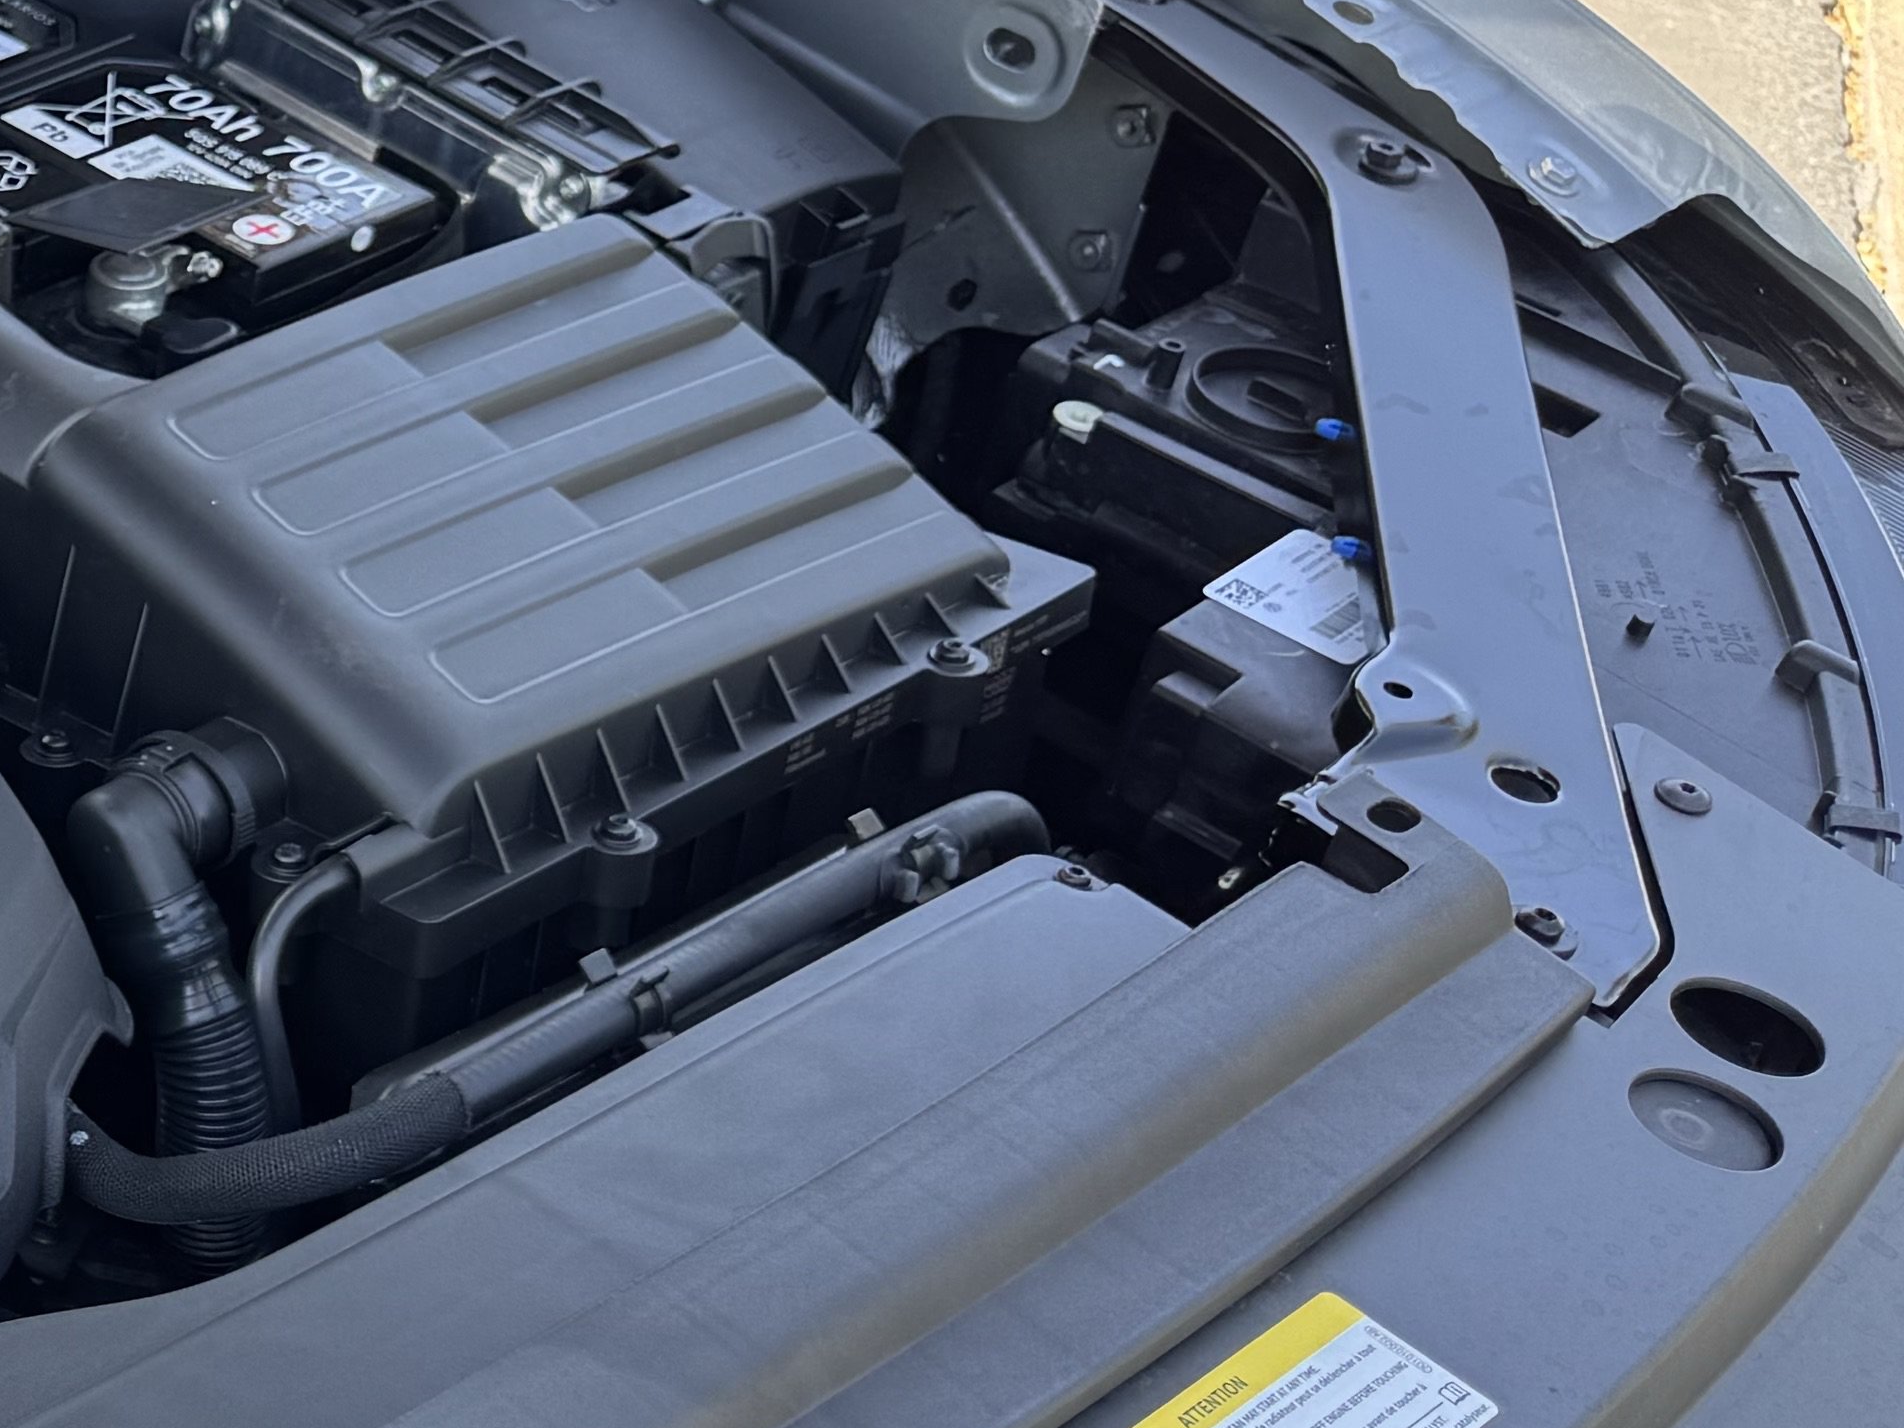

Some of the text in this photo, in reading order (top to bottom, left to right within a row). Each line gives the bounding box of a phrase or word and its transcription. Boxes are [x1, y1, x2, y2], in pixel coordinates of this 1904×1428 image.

[145, 74, 265, 143] 70Ah
[263, 135, 389, 209] 700A
[1175, 1375, 1249, 1428] ATTENTION
